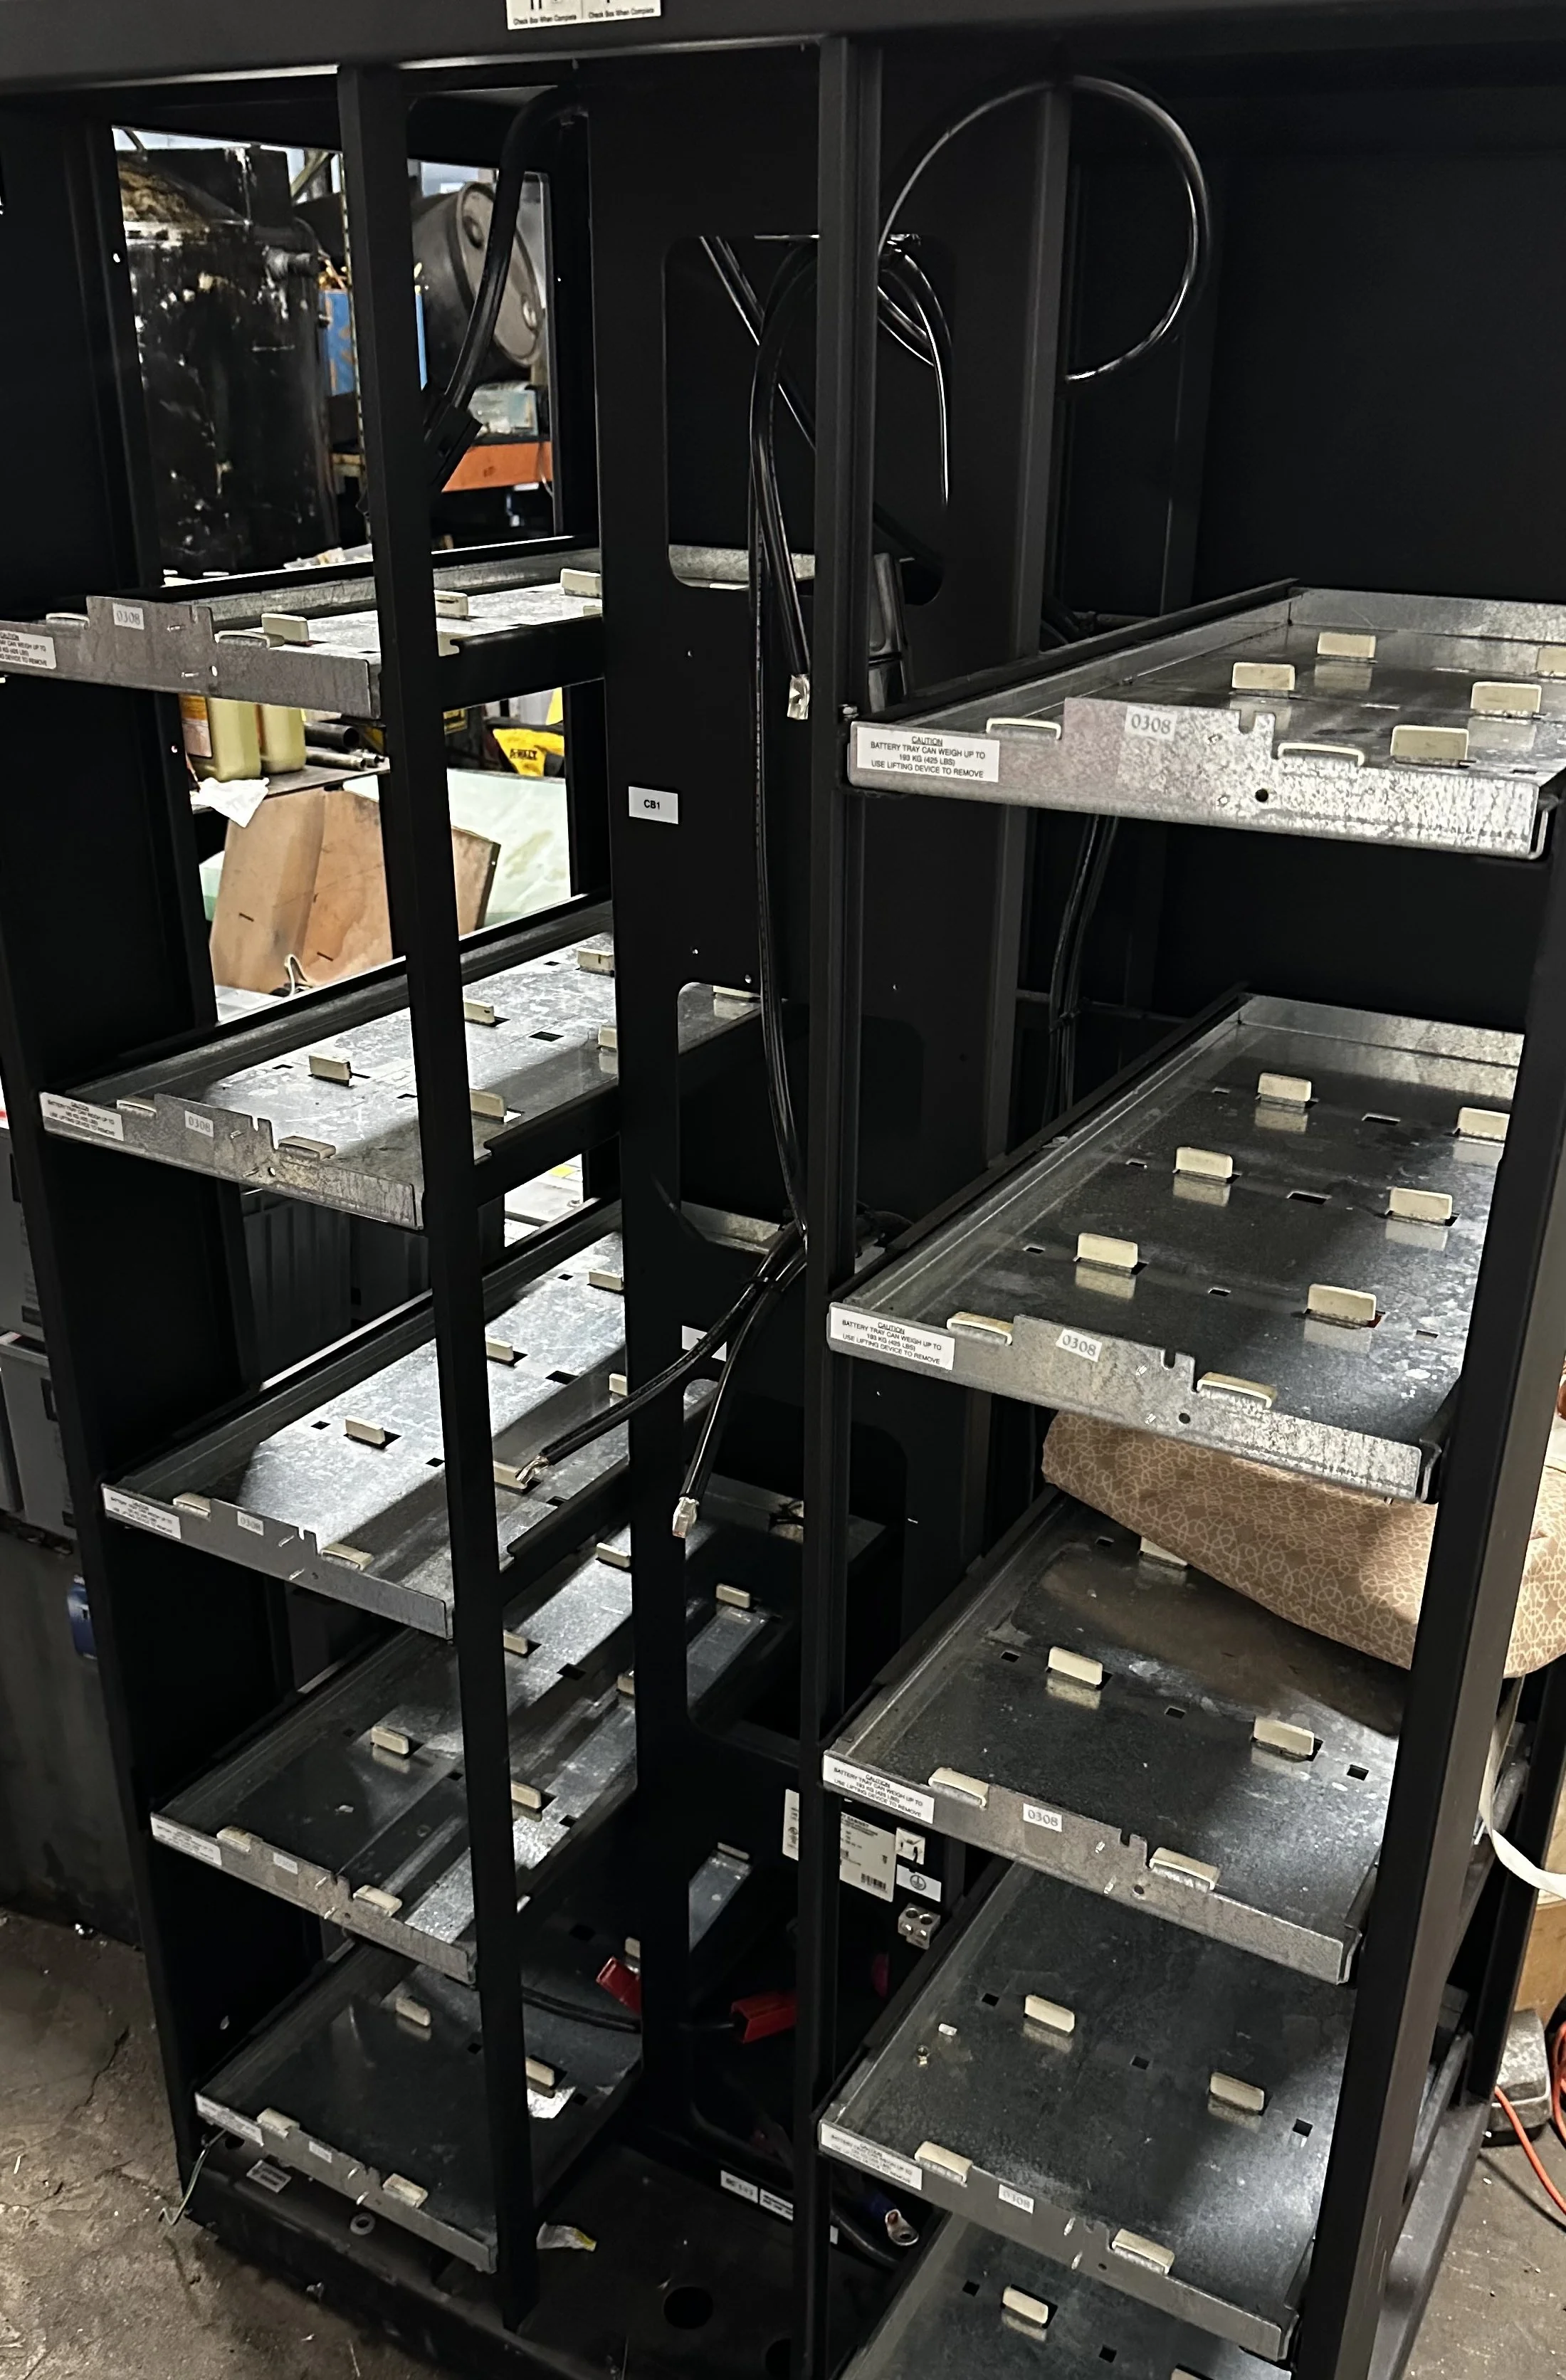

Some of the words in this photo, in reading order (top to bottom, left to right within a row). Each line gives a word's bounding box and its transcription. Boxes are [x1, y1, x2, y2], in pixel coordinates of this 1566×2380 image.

[117, 611, 140, 625] 0308
[1131, 714, 1171, 734] 0308
[871, 741, 900, 751] BATTERY
[922, 746, 937, 754] CAN
[938, 748, 962, 757] WEIGH
[964, 749, 974, 758] UP
[912, 735, 943, 747] CAUTION
[871, 759, 885, 768] USE
[887, 762, 913, 771] LIFTING
[915, 764, 940, 774] DEVICE
[953, 768, 984, 779] REMOVE
[940, 758, 955, 767] LBS)
[643, 799, 661, 810] CB1
[189, 1116, 211, 1133] 0308
[842, 1320, 868, 1332] BATTERY
[870, 1327, 885, 1335] TRAY
[901, 1335, 922, 1345] WEIGH
[878, 1322, 905, 1334] CAUTION
[842, 1333, 855, 1342] USE
[914, 1352, 940, 1364] REMOVE
[1062, 1334, 1096, 1356] 0308
[1028, 1809, 1058, 1827] 0308
